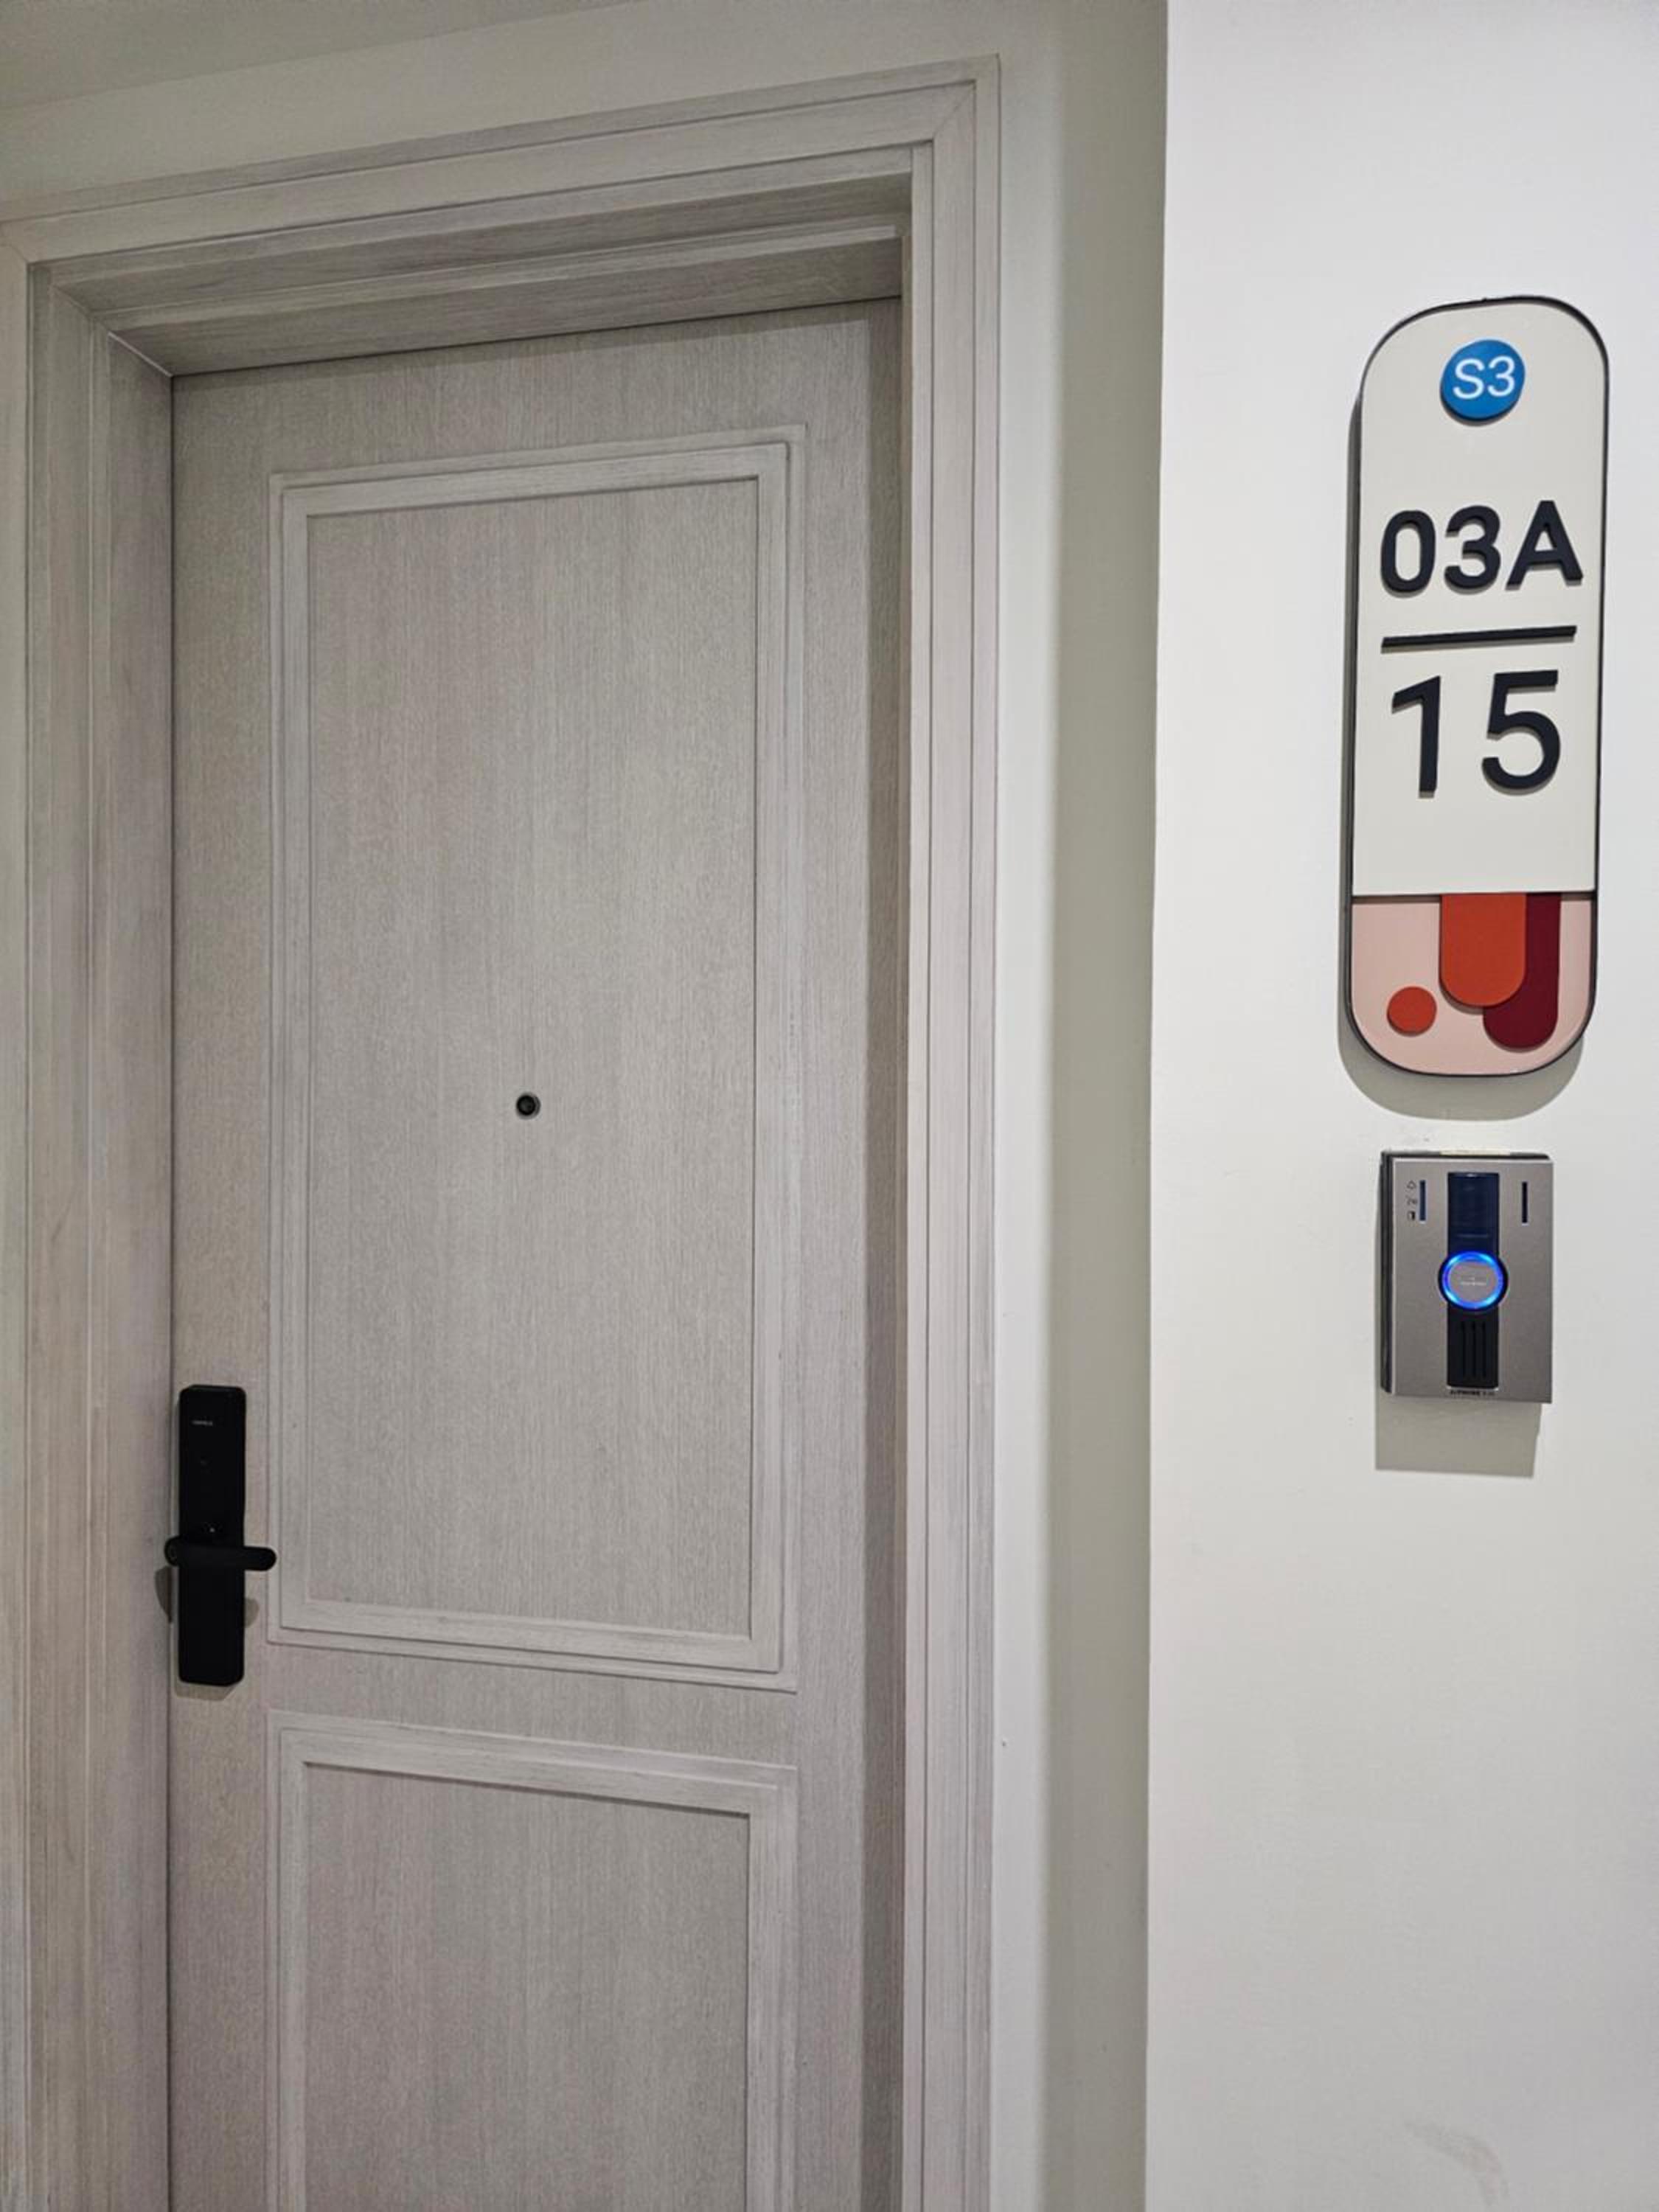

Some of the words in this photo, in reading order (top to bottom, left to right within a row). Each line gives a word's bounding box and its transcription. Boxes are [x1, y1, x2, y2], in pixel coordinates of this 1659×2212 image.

[1453, 355, 1516, 400] S3
[1380, 500, 1584, 594] 03A
[1391, 669, 1561, 793] 15
